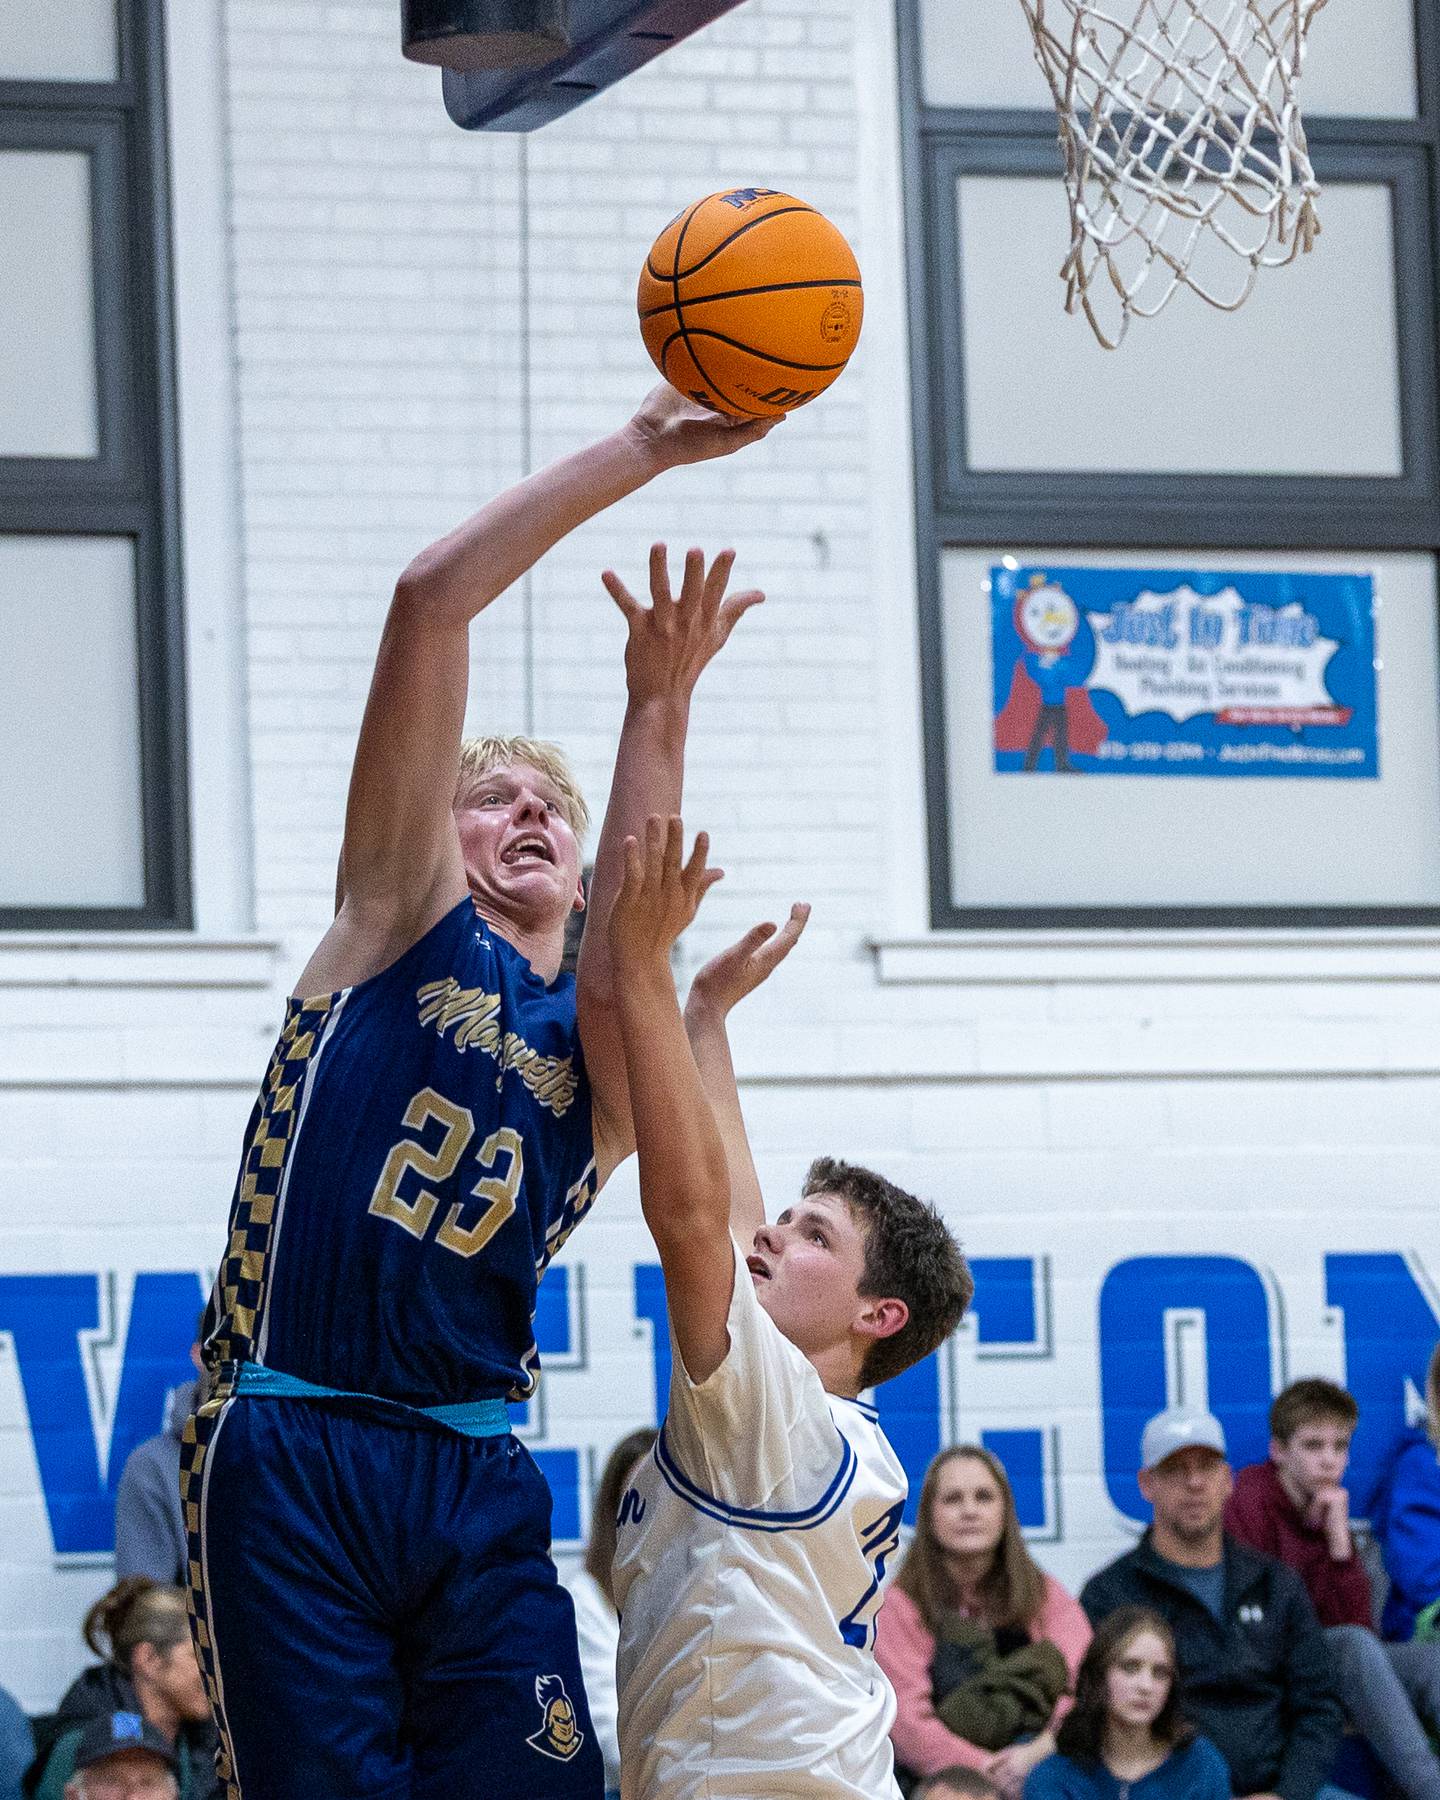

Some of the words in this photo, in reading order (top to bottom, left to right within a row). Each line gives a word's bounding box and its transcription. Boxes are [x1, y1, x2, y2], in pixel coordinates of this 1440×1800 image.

[1103, 602, 1178, 646] Just
[1237, 603, 1319, 647] Time
[416, 976, 579, 1119] Maquette
[368, 1086, 524, 1259] 23
